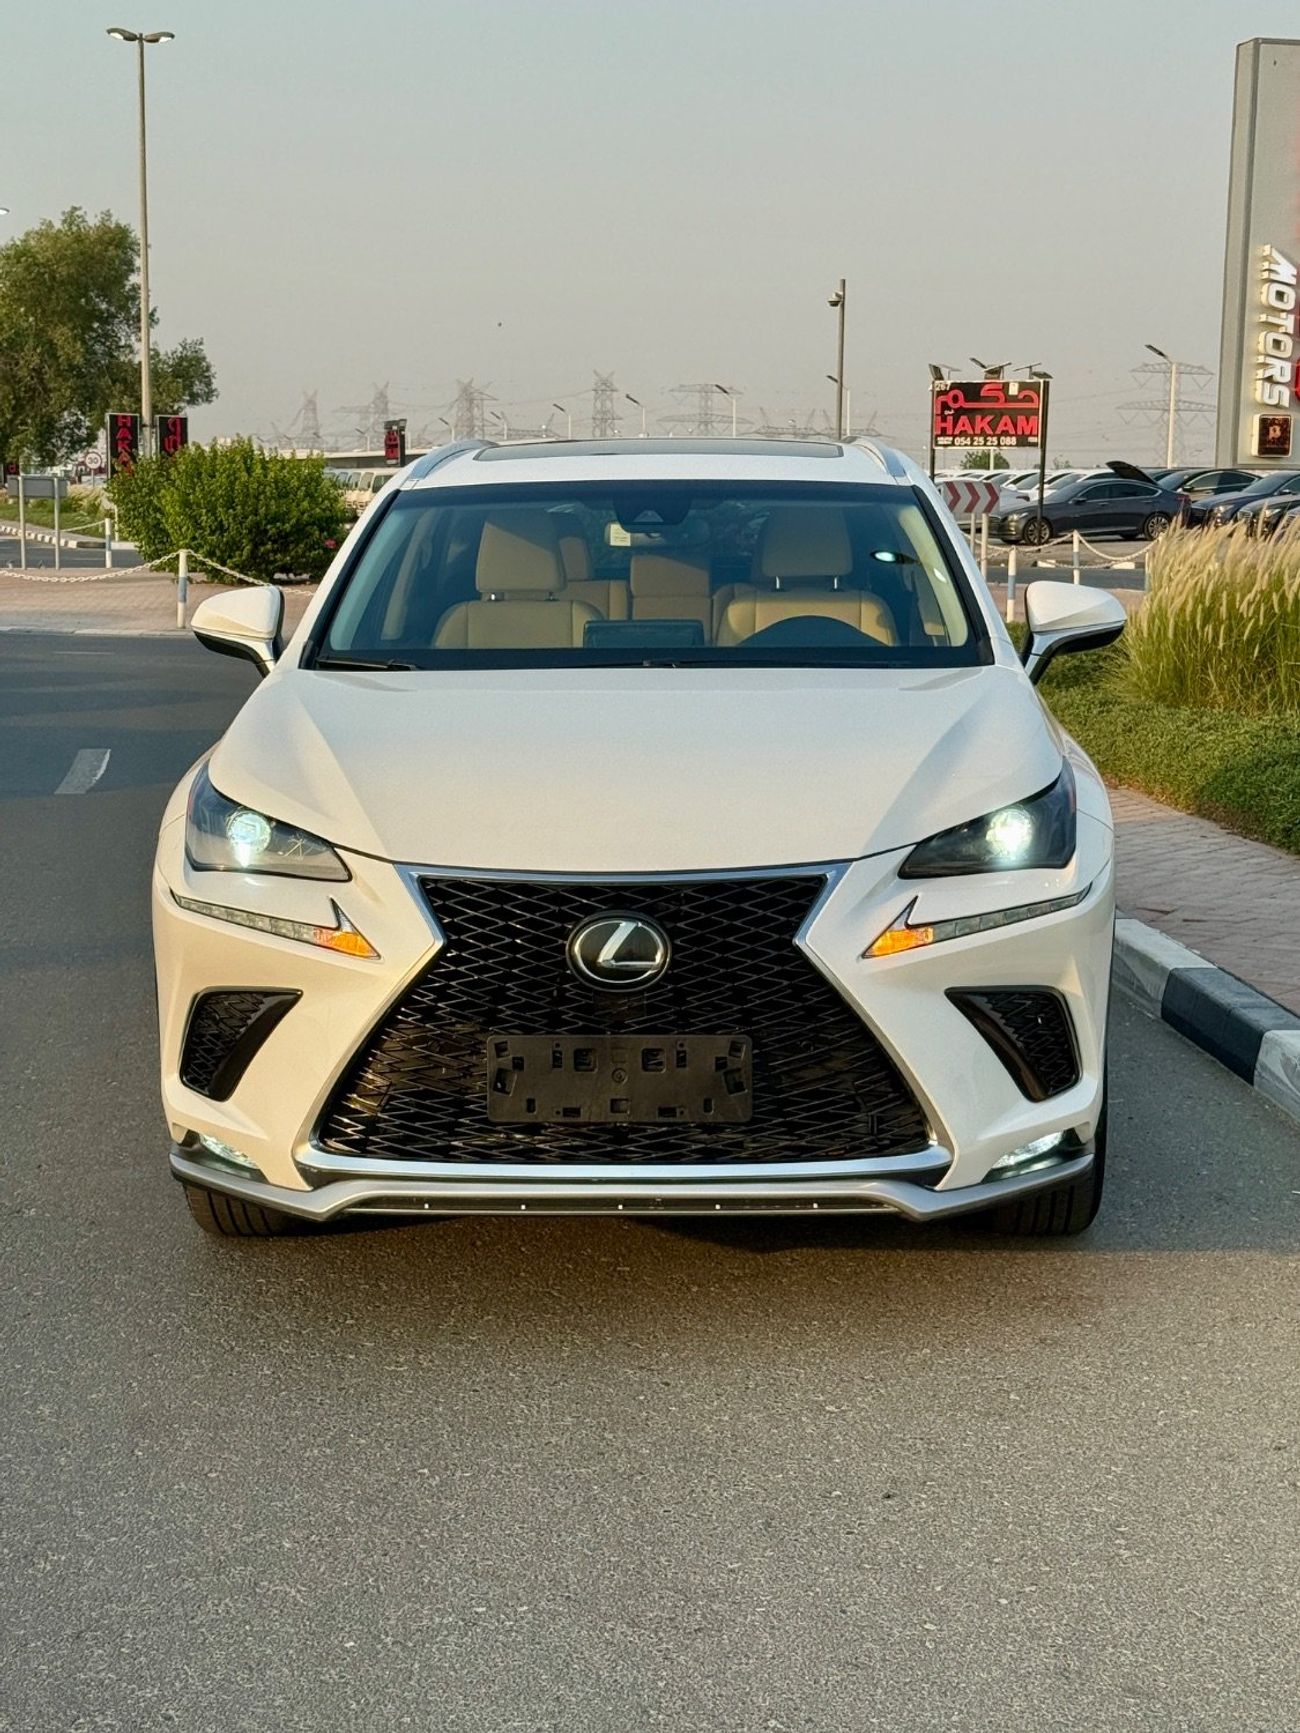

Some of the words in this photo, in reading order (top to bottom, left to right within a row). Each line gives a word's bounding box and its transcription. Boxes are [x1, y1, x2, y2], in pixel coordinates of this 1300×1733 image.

[1257, 243, 1297, 409] MOTORS
[935, 383, 1039, 415] حكم
[935, 415, 1038, 435] HAKAM
[954, 436, 971, 446] 054
[973, 436, 985, 446] 25
[986, 436, 998, 446] 25
[1000, 436, 1017, 446] 088
[115, 415, 134, 475] HAKA
